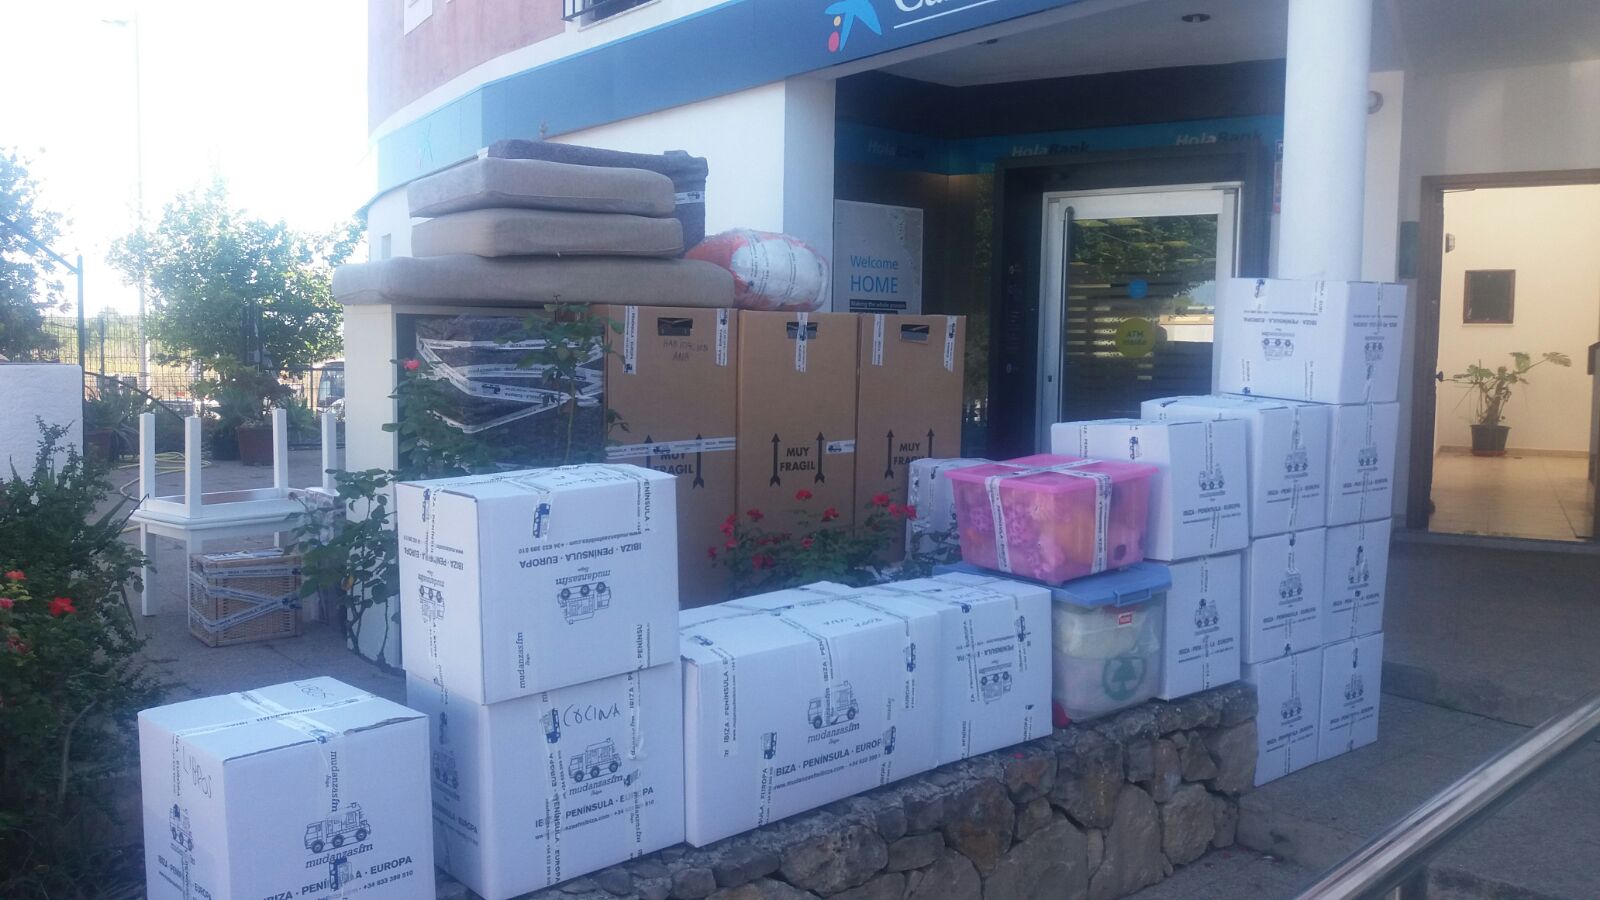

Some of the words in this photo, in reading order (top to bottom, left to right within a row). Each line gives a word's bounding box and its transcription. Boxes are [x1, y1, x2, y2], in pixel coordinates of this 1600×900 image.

[850, 255, 898, 270] Welcome
[850, 275, 898, 294] HOME
[786, 447, 810, 458] MUY
[899, 443, 921, 452] MUY
[779, 461, 816, 472] FRAGIL
[565, 547, 614, 562] PENÍNSULA
[620, 542, 642, 553] IBIZA
[520, 556, 559, 569] EUROPA
[516, 632, 526, 689] mudanzasfm
[563, 702, 620, 728] COCINA
[807, 722, 860, 744] mudanzasfm
[803, 748, 850, 769] PENÍNSULA
[330, 751, 341, 812] mudanzasfm
[569, 774, 623, 796] mudanzasfm
[565, 798, 614, 819] PENÍNSULA
[305, 843, 373, 869] mudanzasfm
[370, 854, 413, 875] EUROPA
